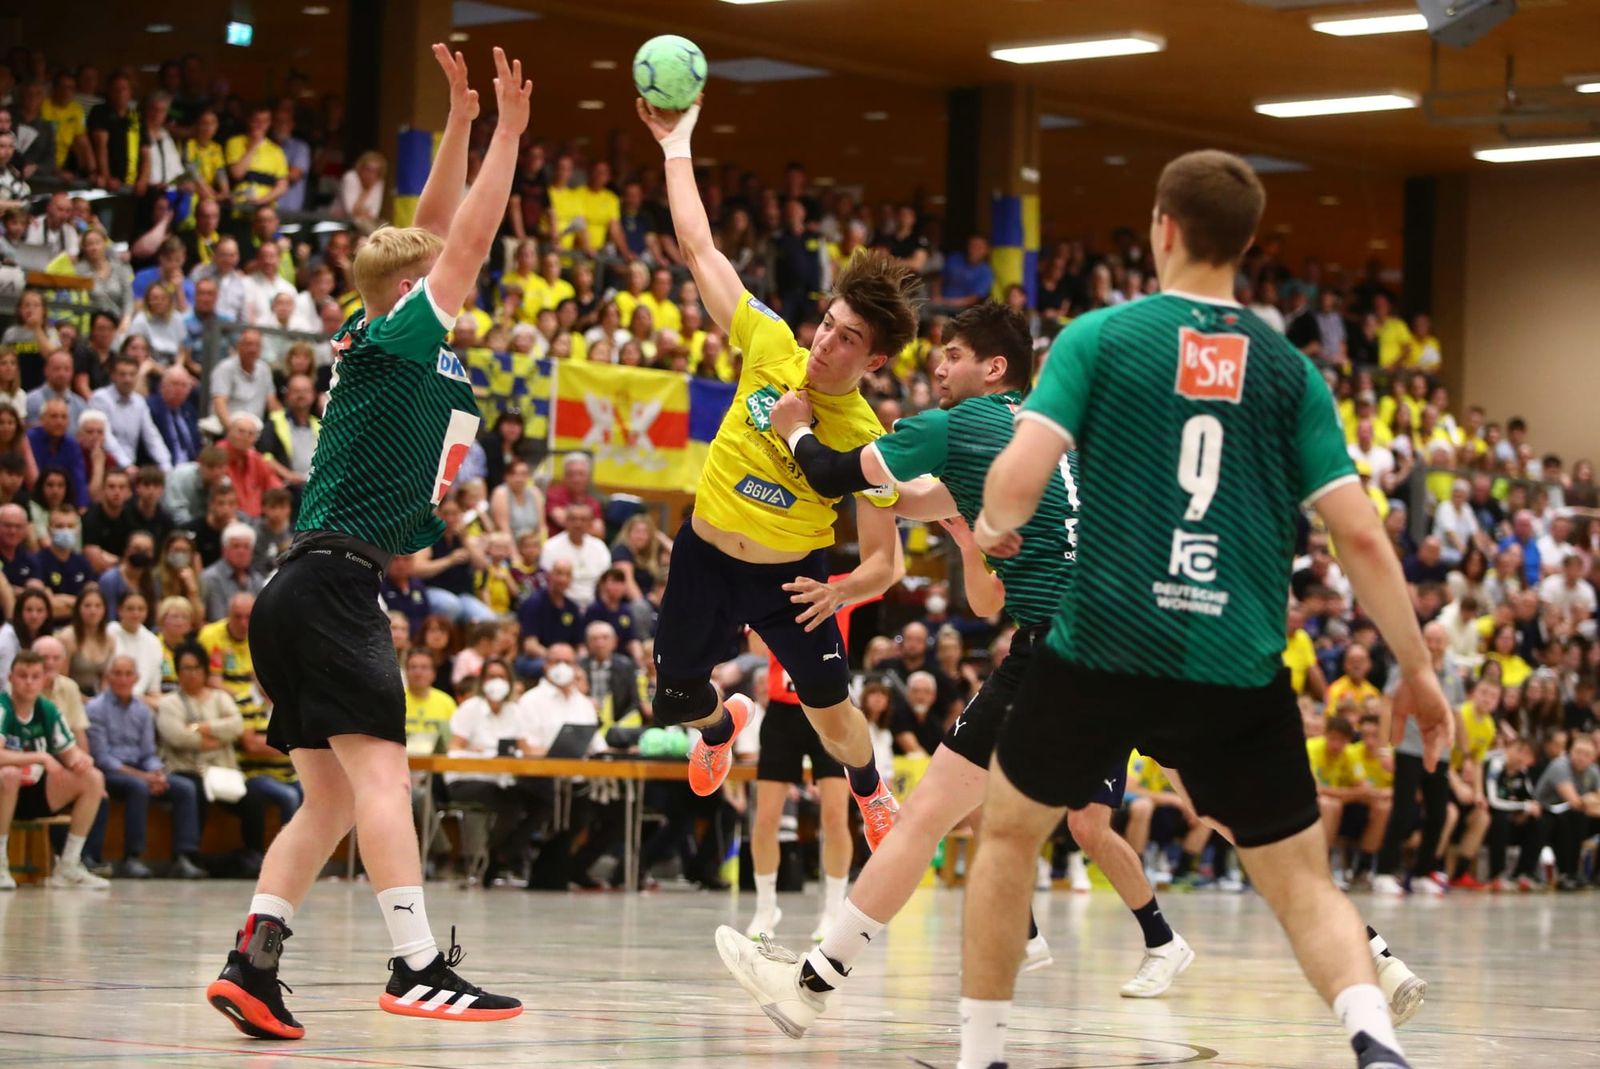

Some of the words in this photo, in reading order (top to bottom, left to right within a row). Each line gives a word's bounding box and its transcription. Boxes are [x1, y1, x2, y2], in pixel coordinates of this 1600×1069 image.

[1185, 341, 1236, 387] BSR
[747, 394, 769, 429] Bank
[1177, 413, 1224, 521] 9
[1152, 581, 1229, 605] DEUTSCHE
[1156, 595, 1223, 616] WOHNEN
